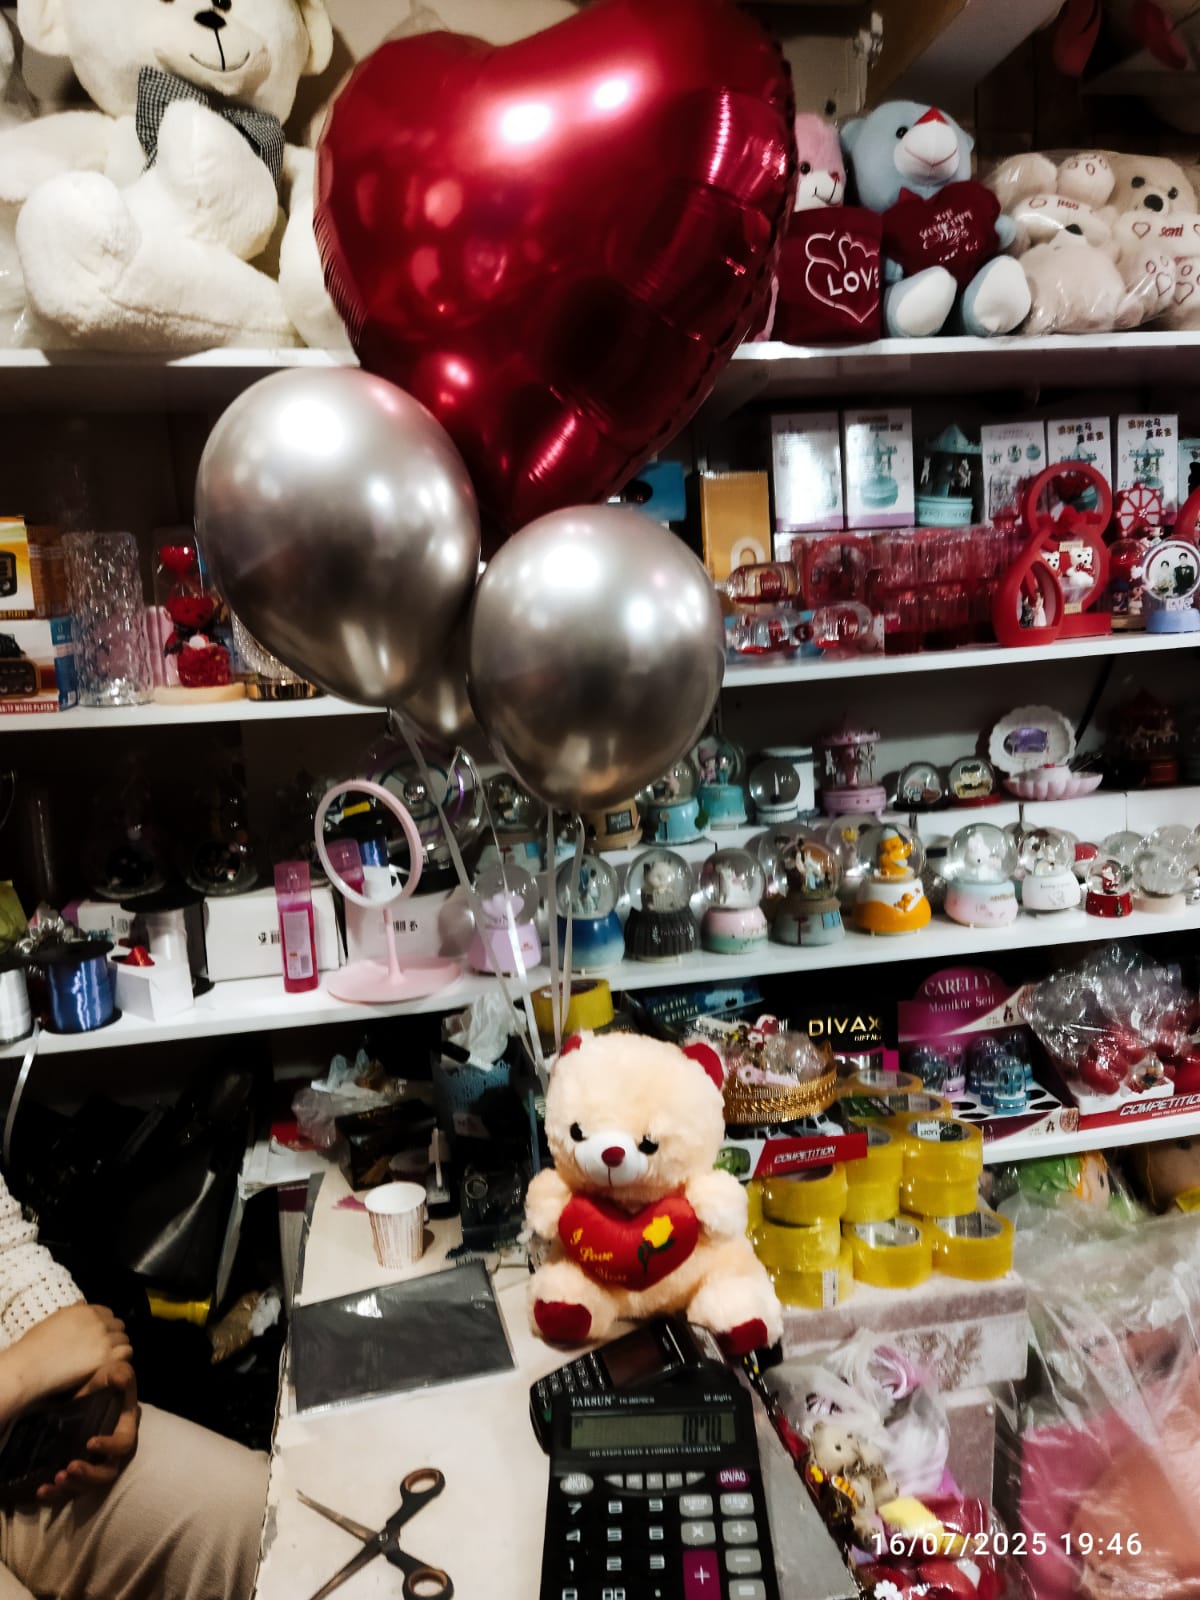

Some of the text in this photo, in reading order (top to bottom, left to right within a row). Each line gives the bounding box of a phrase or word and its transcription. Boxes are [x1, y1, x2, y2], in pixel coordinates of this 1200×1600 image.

[924, 975, 992, 996] CARELLY
[808, 1015, 880, 1036] DIVAX
[774, 1145, 836, 1164] COMPETITION
